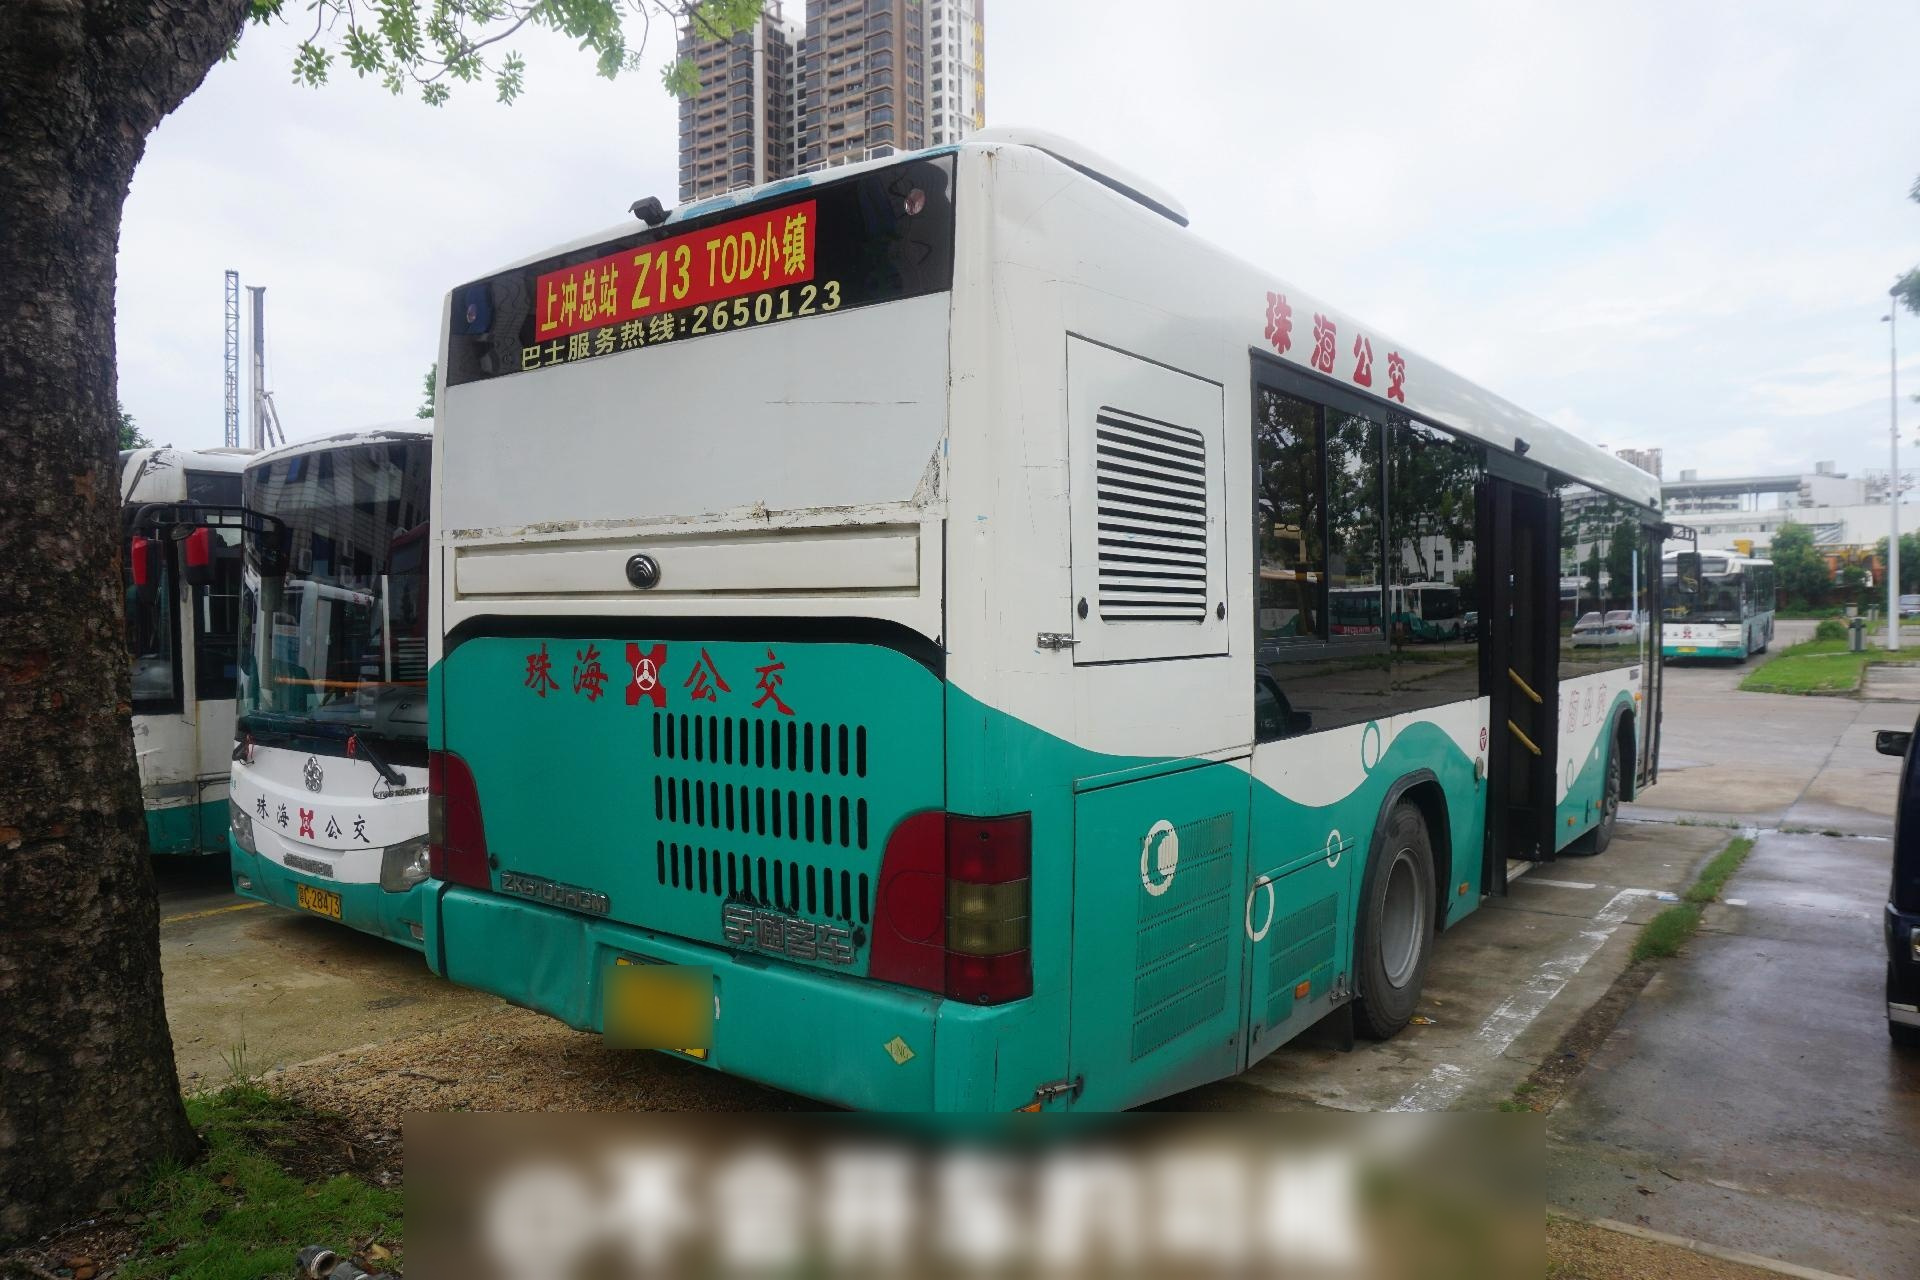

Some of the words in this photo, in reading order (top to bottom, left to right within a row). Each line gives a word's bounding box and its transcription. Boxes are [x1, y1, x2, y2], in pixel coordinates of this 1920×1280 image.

[541, 263, 618, 331] 上冲总站
[631, 245, 691, 311] Z13
[707, 213, 807, 287] TOD小镇
[1264, 291, 1405, 403] 珠海公交
